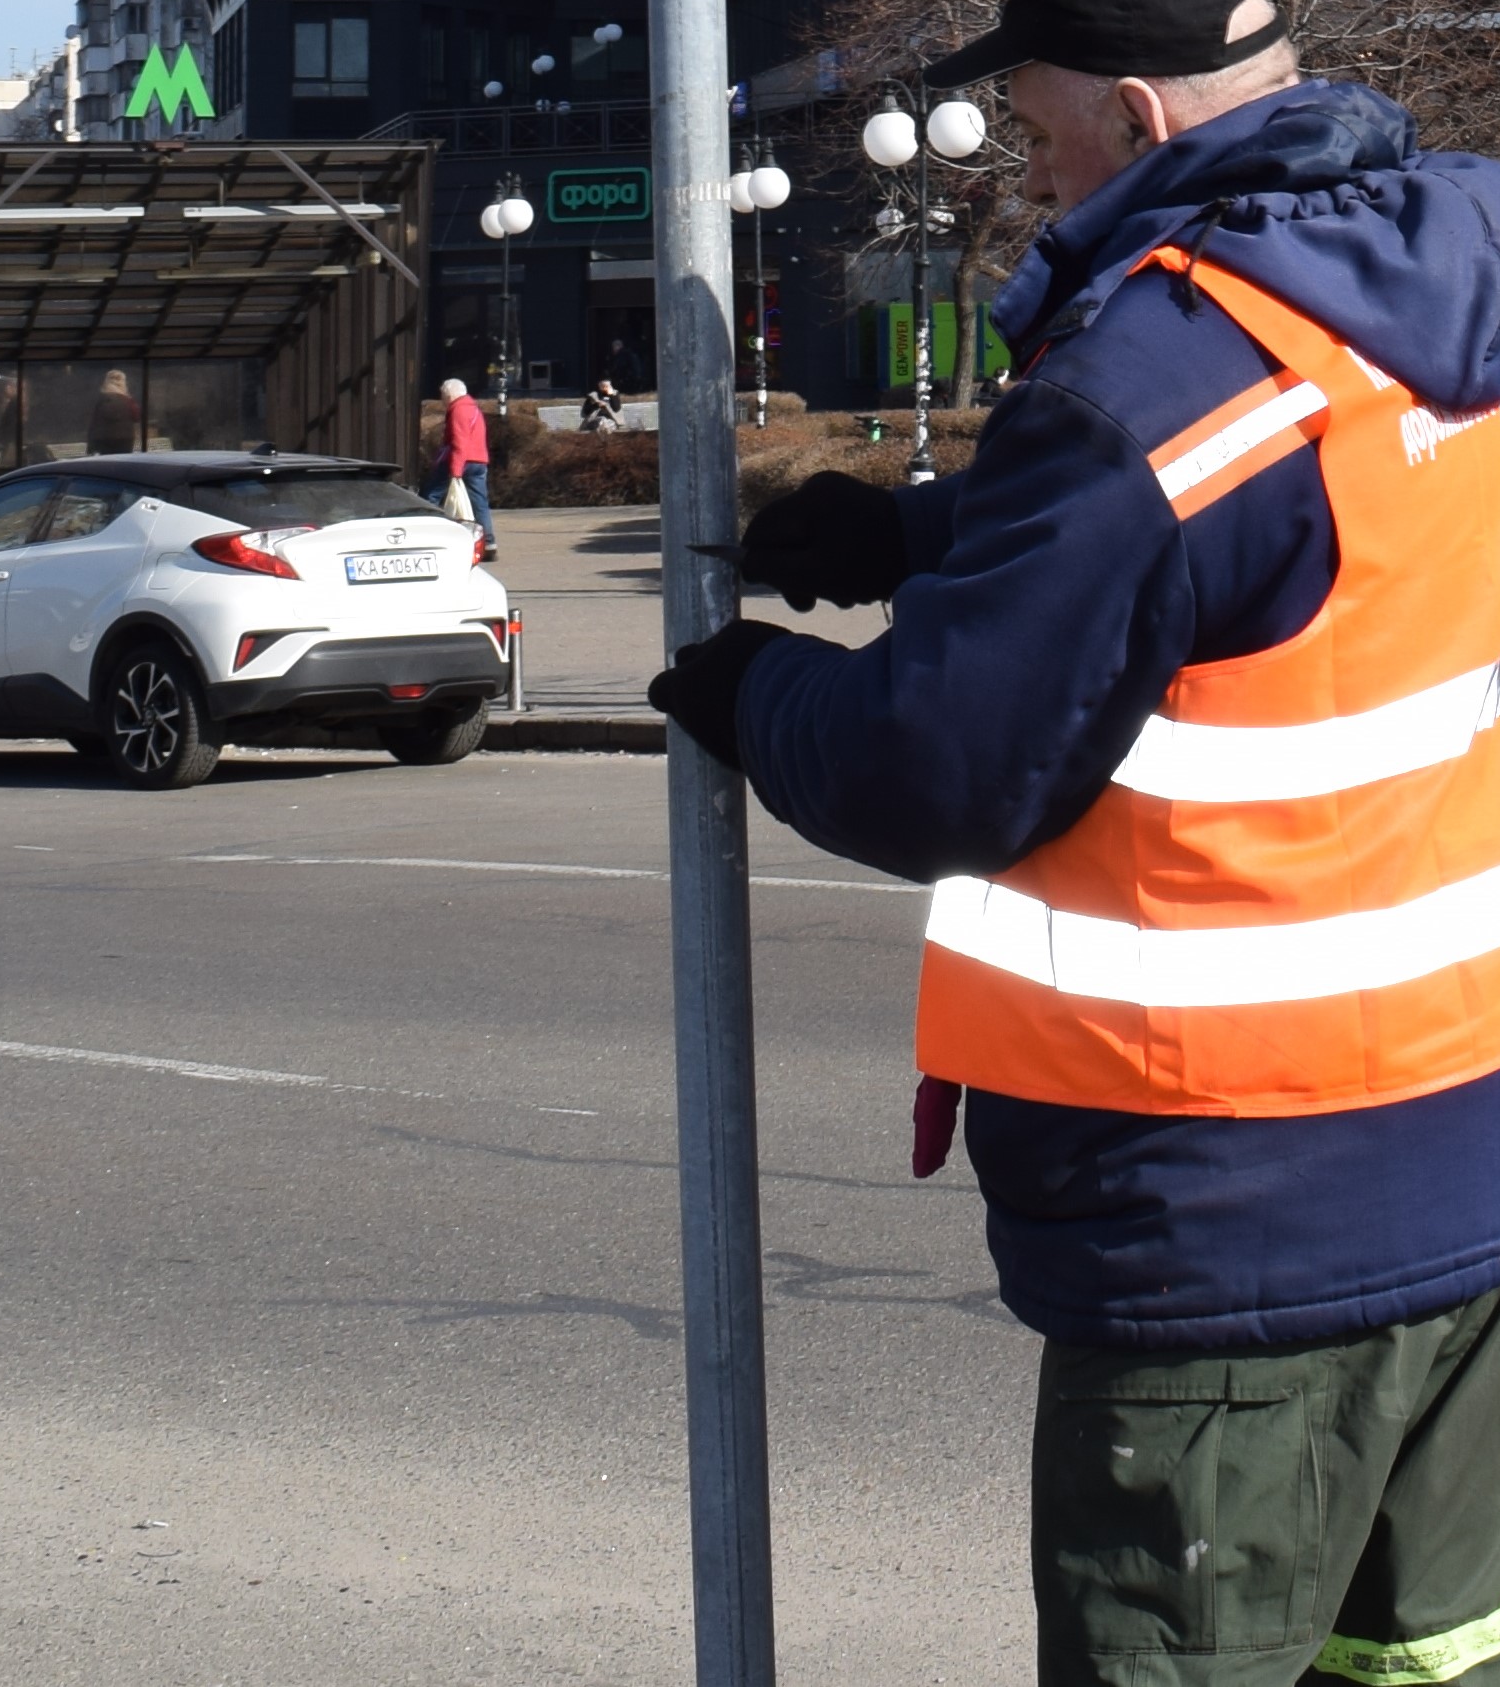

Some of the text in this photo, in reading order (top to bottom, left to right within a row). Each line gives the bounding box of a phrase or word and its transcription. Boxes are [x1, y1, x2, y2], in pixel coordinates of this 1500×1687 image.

[561, 183, 638, 210] фора
[358, 557, 433, 577] KA 6106 KT
